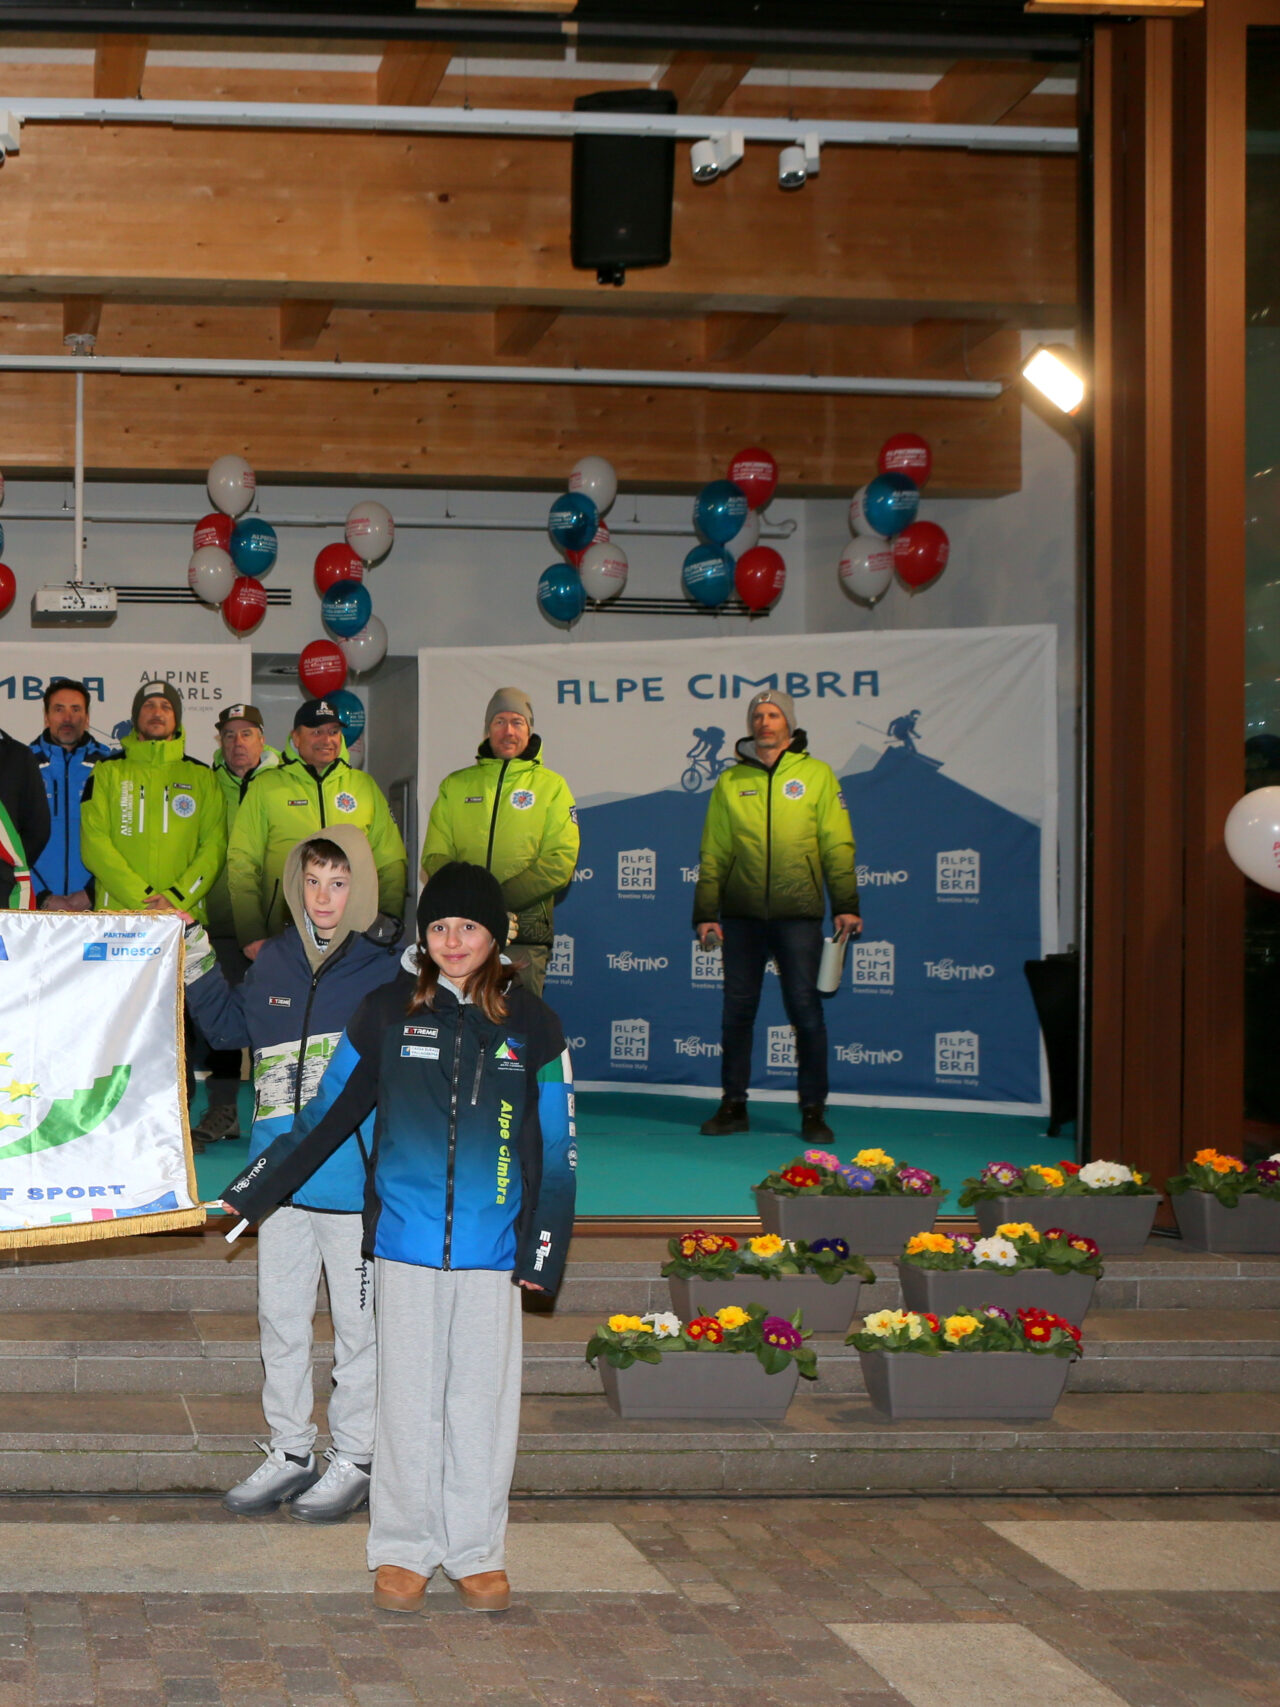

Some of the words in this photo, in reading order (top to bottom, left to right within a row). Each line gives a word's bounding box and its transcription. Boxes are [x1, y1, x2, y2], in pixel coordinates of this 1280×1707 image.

[557, 677, 665, 704] ALPE
[687, 670, 880, 699] CIMBRA
[178, 687, 223, 700] ARLS
[621, 855, 652, 863] ALPE
[940, 856, 975, 865] ALPE
[621, 866, 652, 876] CIM
[940, 868, 976, 878] CIM
[621, 877, 652, 887] BRA
[856, 870, 908, 886] ENTINO
[940, 880, 975, 890] BRA
[556, 941, 570, 949] PE
[111, 946, 161, 956] unesco
[856, 948, 890, 956] ALPE
[547, 963, 570, 973] RA
[607, 954, 669, 972] TRENTINO
[856, 960, 890, 970] CIM
[856, 971, 890, 981] BRA
[924, 961, 995, 981] TRENTINO
[615, 1025, 645, 1033] ALPE
[771, 1031, 796, 1039] ALP
[614, 1036, 645, 1046] CIM
[939, 1037, 974, 1047] ALPE
[614, 1047, 645, 1057] BRA
[673, 1039, 723, 1057] TRENTIN
[834, 1045, 903, 1065] TRENTINO
[939, 1049, 975, 1060] CIM
[939, 1061, 974, 1072] BRA
[498, 1099, 513, 1140] Alpe
[27, 1184, 125, 1200] SPORT
